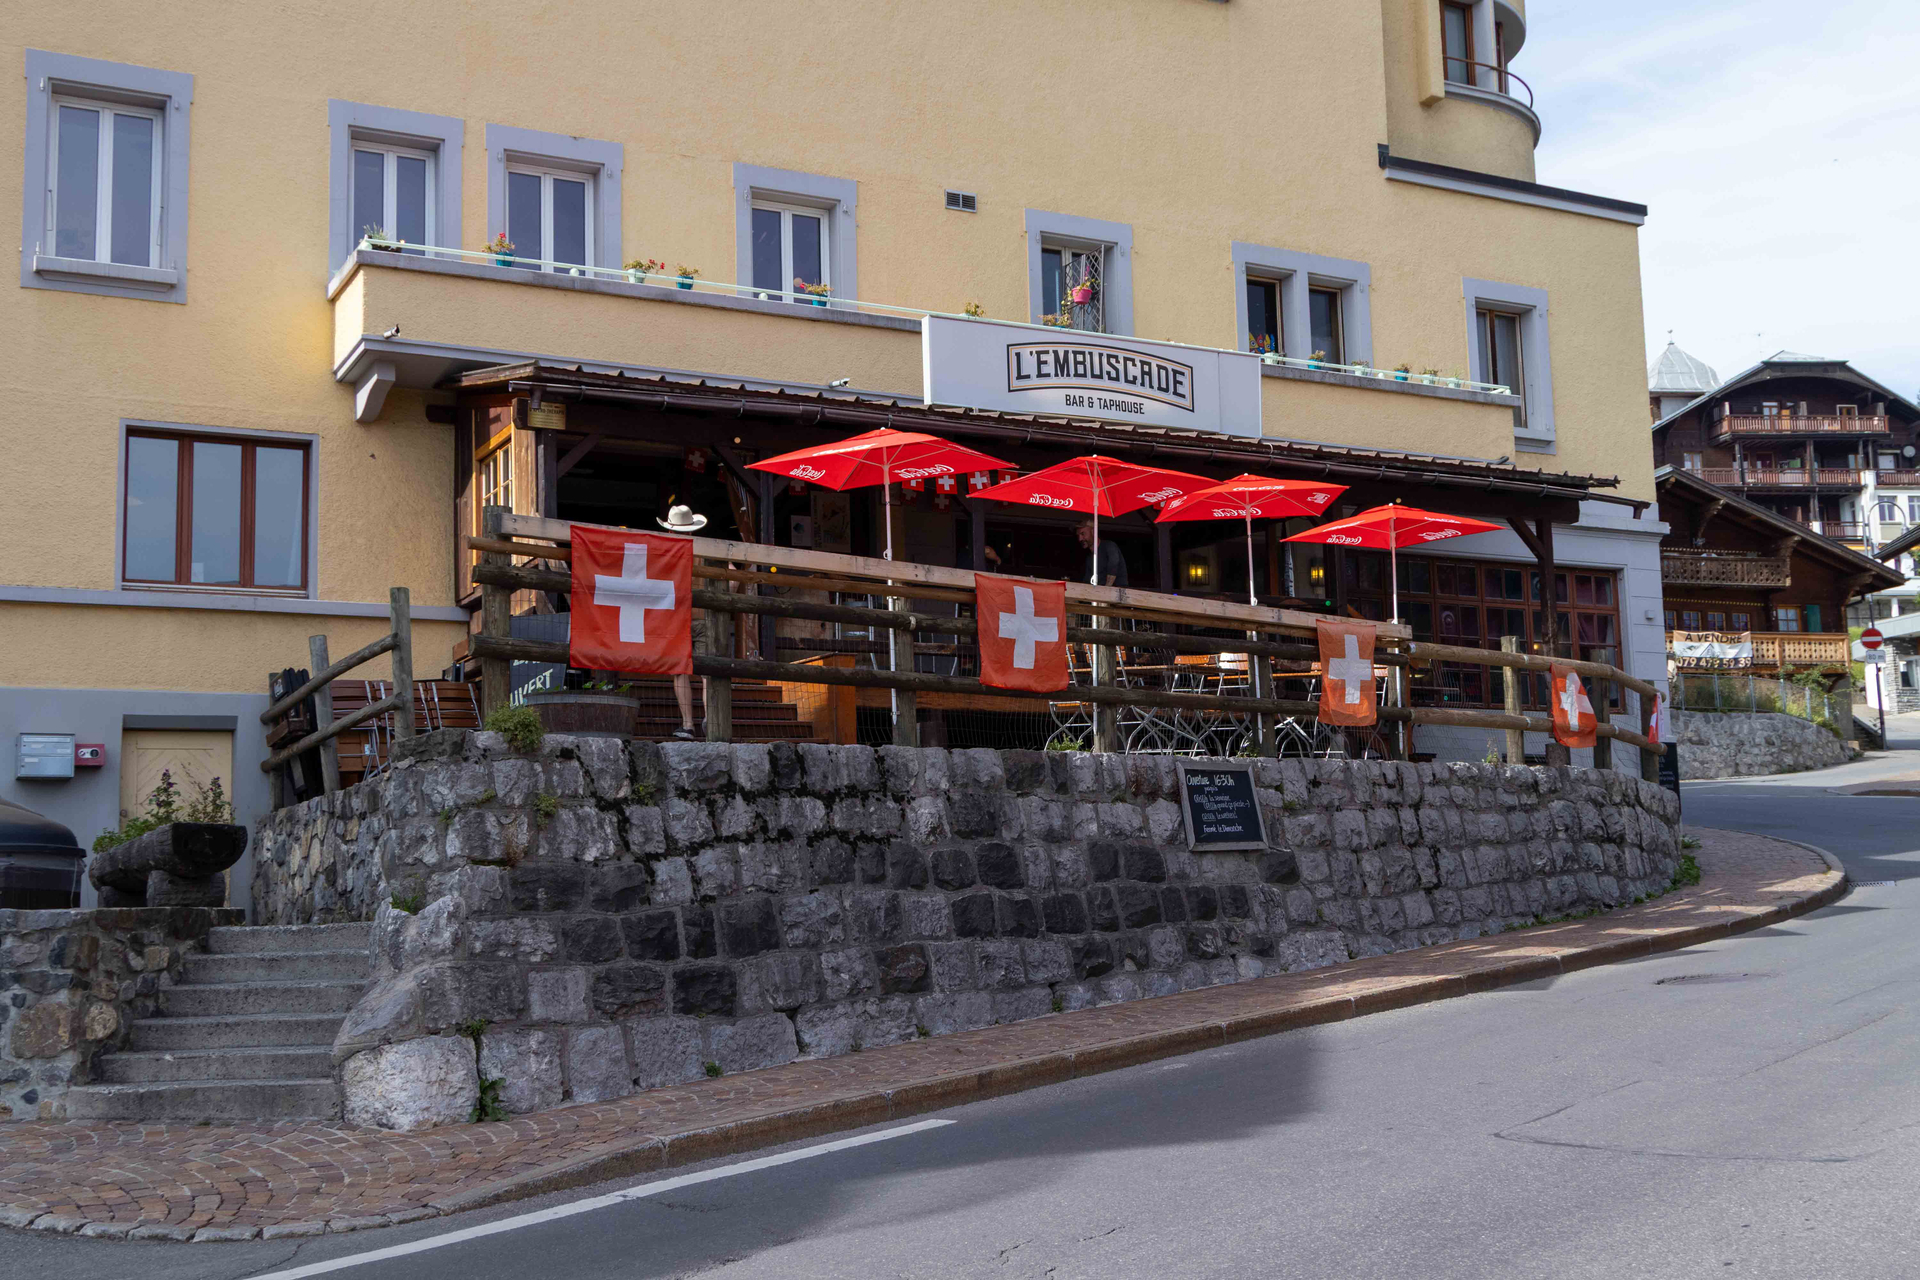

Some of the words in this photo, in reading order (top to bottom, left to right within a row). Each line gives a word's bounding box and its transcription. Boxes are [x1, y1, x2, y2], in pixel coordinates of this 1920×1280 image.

[1014, 349, 1188, 400] L'EMBUSCADE
[1065, 394, 1085, 408] BAR
[1088, 397, 1094, 409] &
[1096, 397, 1145, 415] TAPHOUSE
[1696, 632, 1742, 644] VENDRE
[1676, 657, 1697, 667] 079
[1722, 658, 1735, 668] 59
[1738, 657, 1752, 667] 39
[1868, 653, 1877, 661] 80
